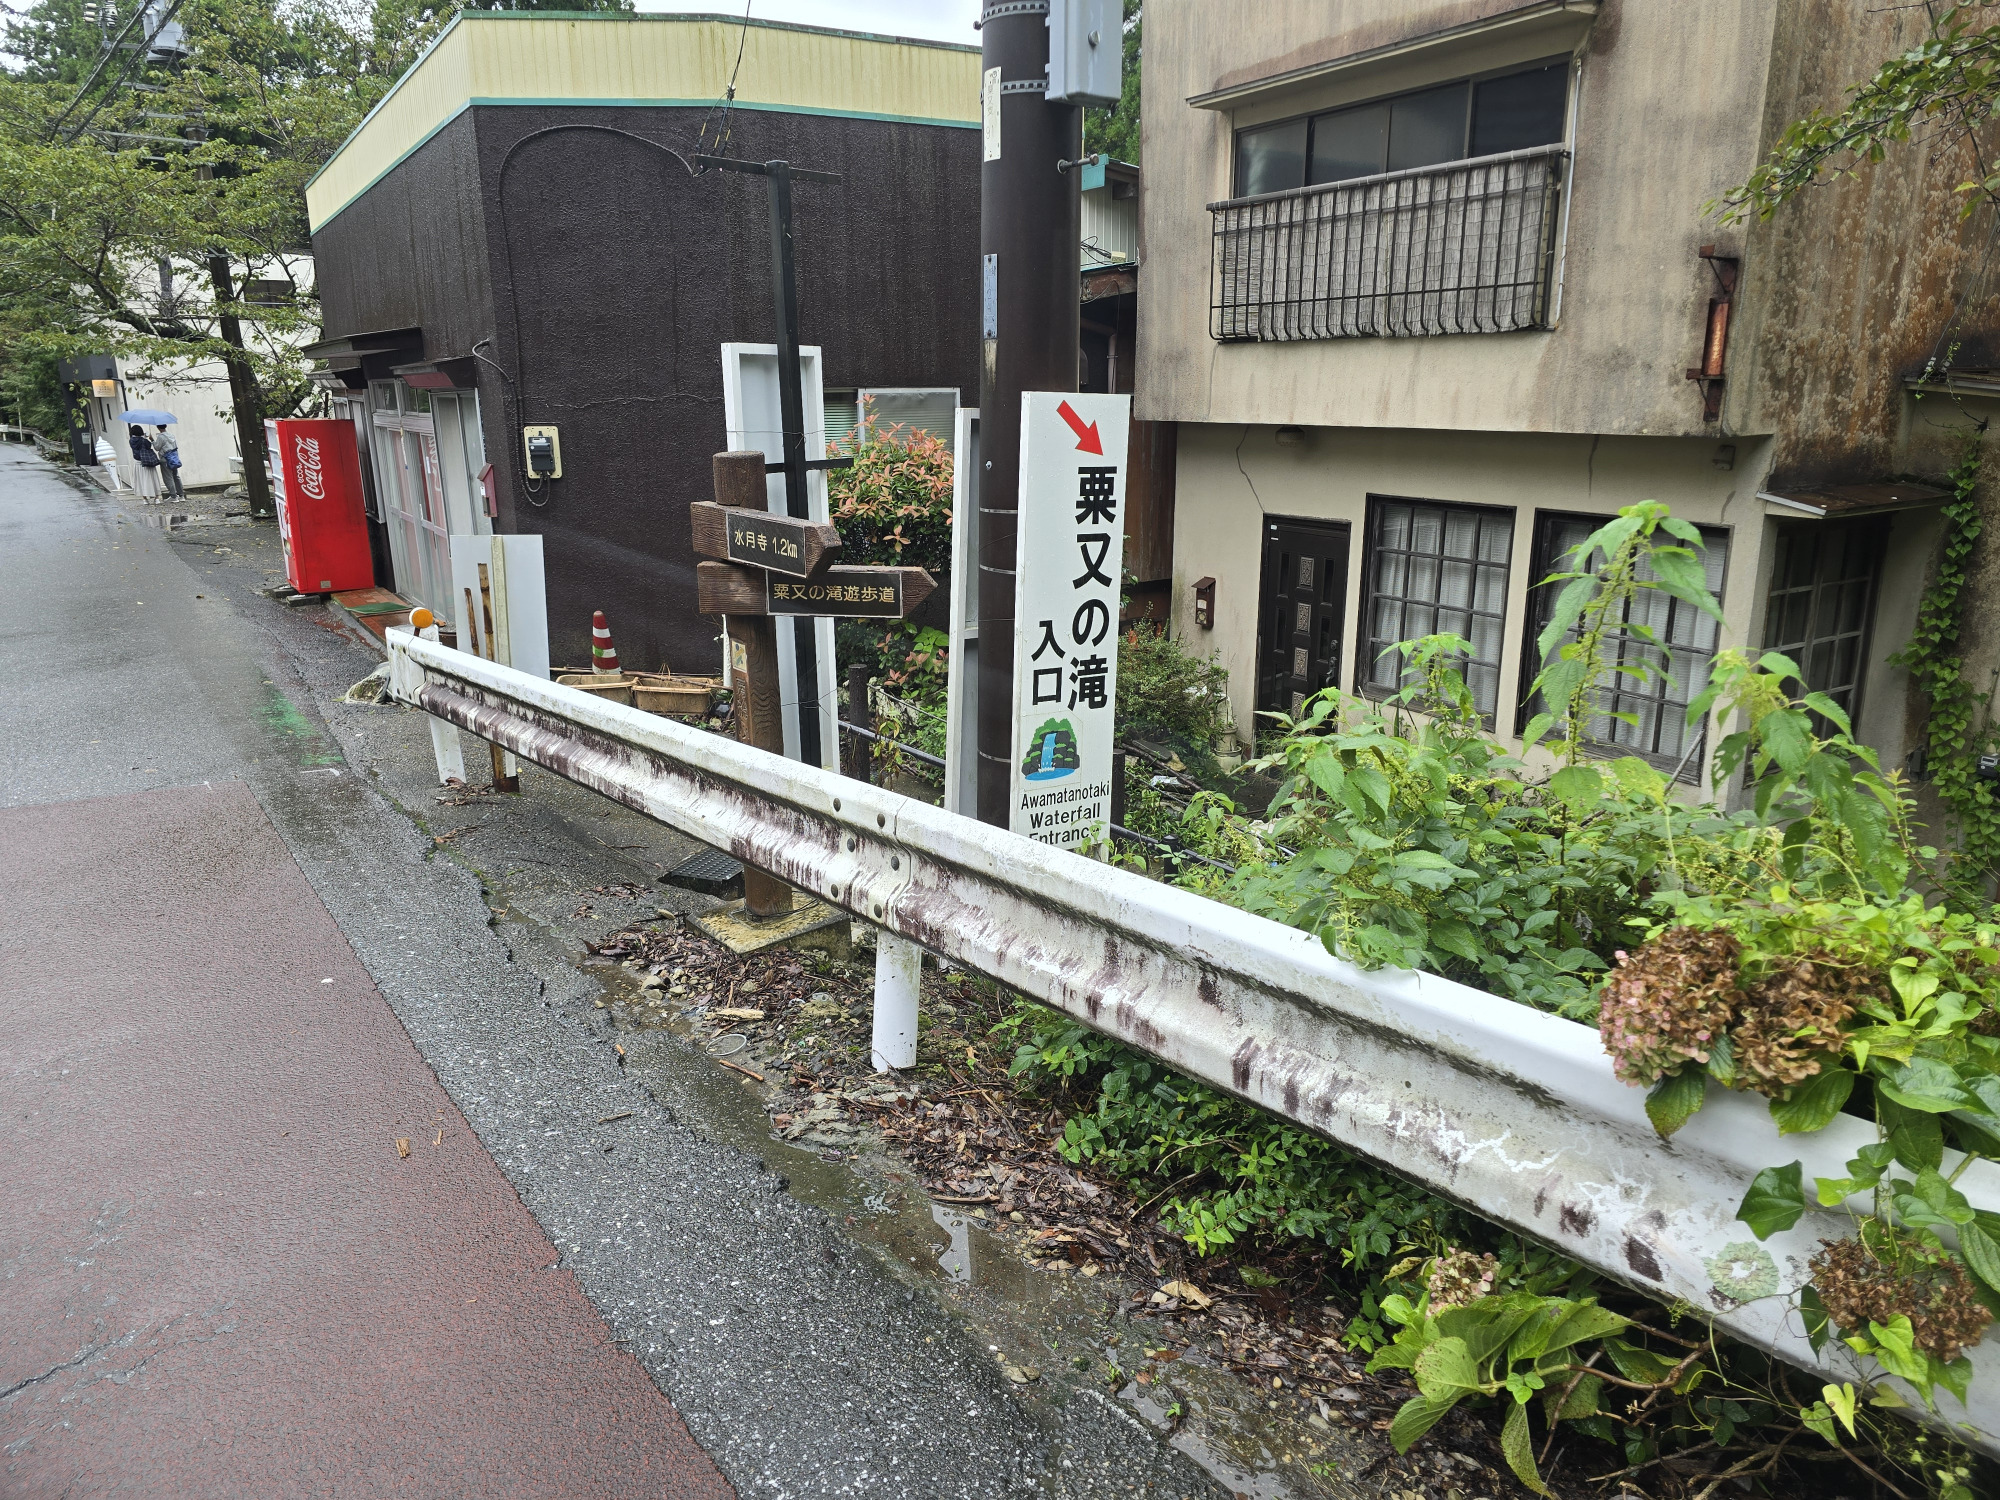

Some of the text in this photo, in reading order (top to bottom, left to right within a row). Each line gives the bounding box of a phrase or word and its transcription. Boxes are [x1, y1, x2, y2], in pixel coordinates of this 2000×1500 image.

[294, 433, 326, 500] Coca-Cola
[734, 529, 798, 559] 水月寺 1.2km
[773, 583, 896, 603] 粟又の滝遊歩道
[1067, 466, 1118, 712] 粟又の滝
[1031, 620, 1066, 706] 入口
[1020, 780, 1110, 810] Awamatanotaki
[1030, 802, 1101, 830] Waterfall
